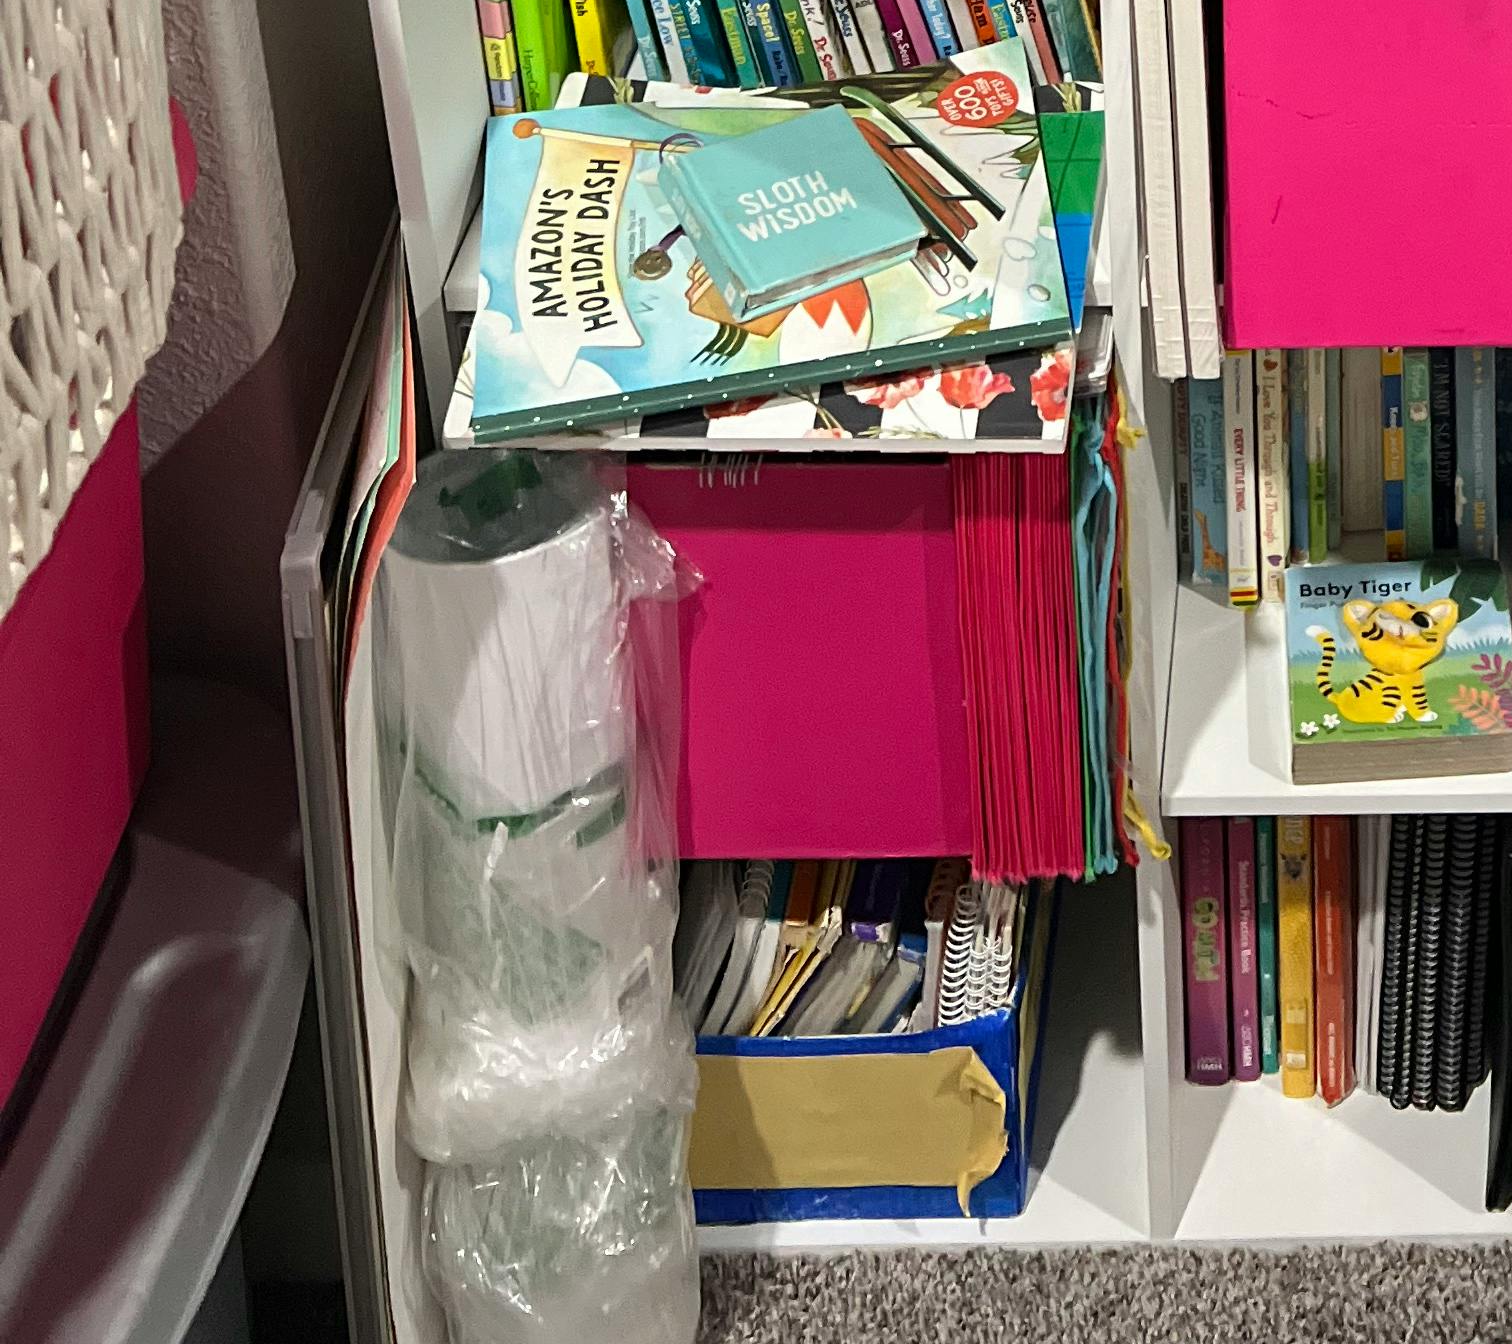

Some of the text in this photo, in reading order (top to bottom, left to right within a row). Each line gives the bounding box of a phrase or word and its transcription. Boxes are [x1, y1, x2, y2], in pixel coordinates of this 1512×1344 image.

[941, 98, 963, 121] OVER
[954, 85, 987, 121] 600
[736, 171, 829, 213] SLOTH
[738, 193, 857, 242] WISDOM
[528, 188, 574, 317] AMAZON'S
[570, 159, 620, 332] HOLIDAY DASH
[1300, 580, 1412, 599] Baby Tiger
